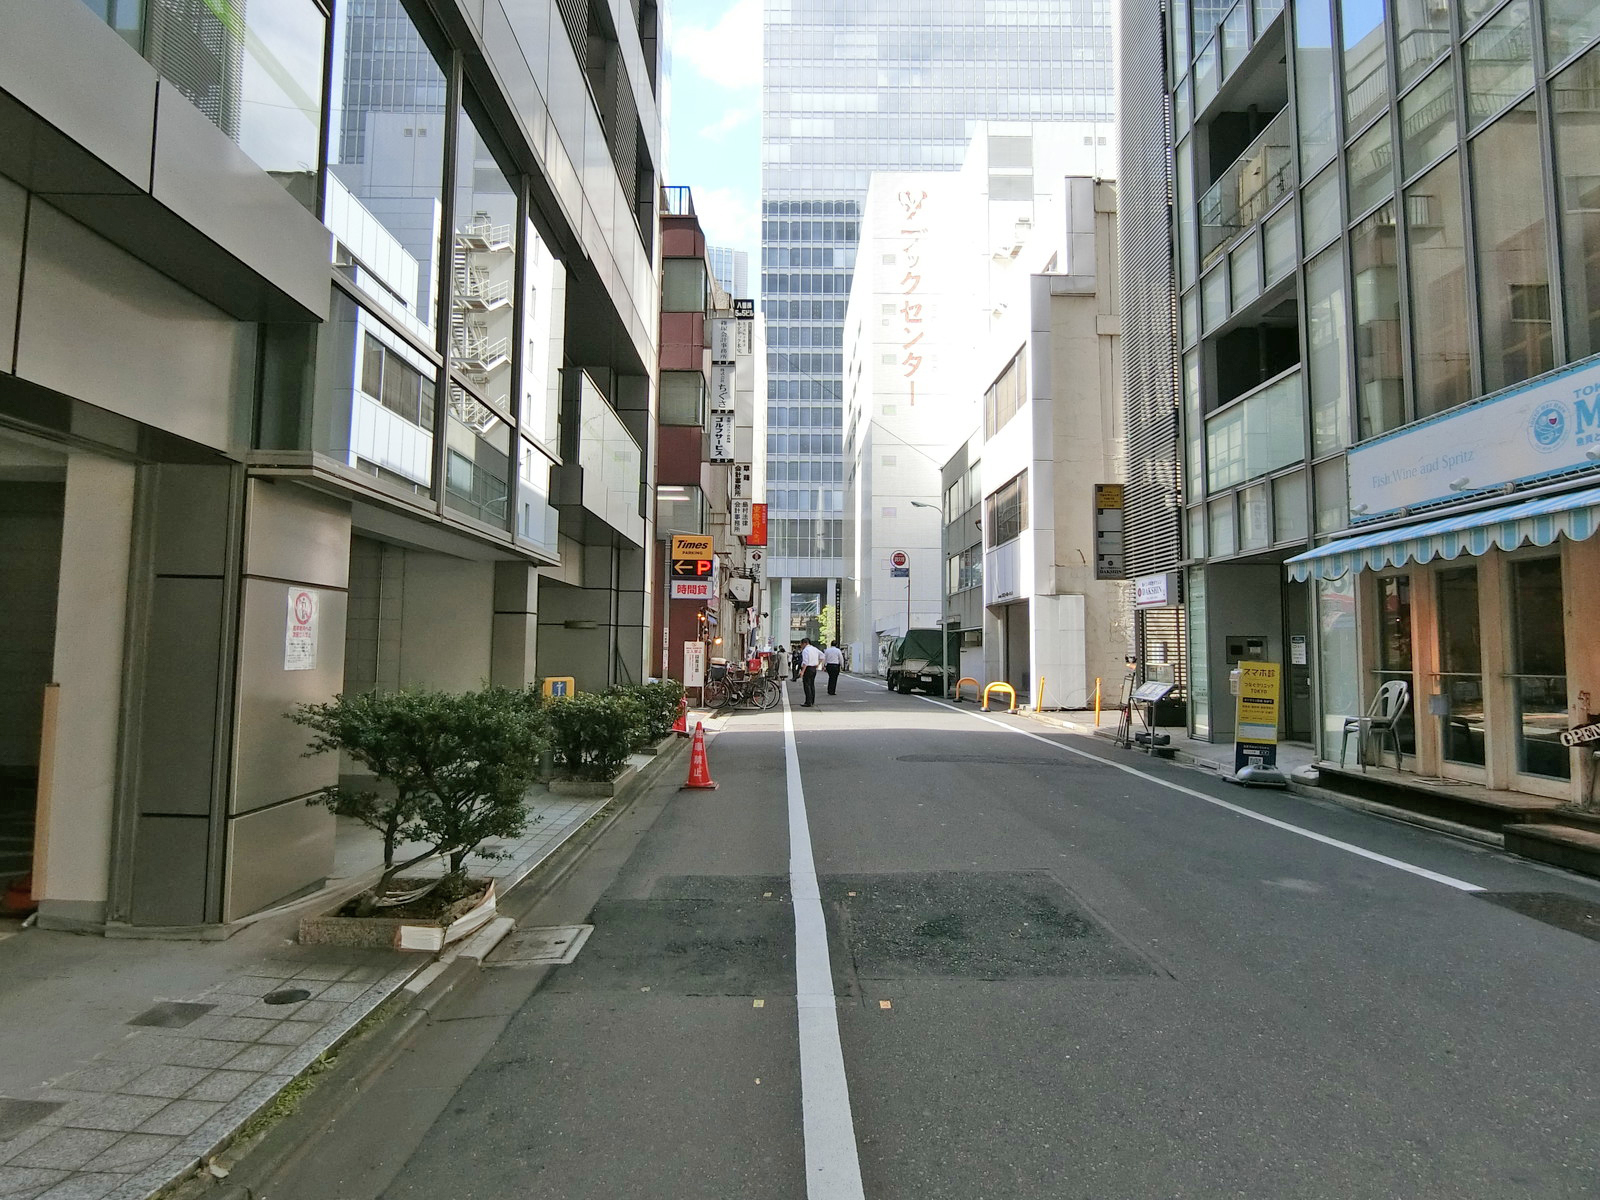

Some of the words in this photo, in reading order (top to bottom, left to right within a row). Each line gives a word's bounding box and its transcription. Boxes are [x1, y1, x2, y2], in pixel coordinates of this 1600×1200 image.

[715, 416, 723, 456] ゴルフサービス
[1420, 457, 1439, 475] and
[1442, 450, 1474, 471] Spritz
[677, 540, 708, 549] Times
[697, 560, 711, 575] P
[677, 584, 707, 595] 時間貸
